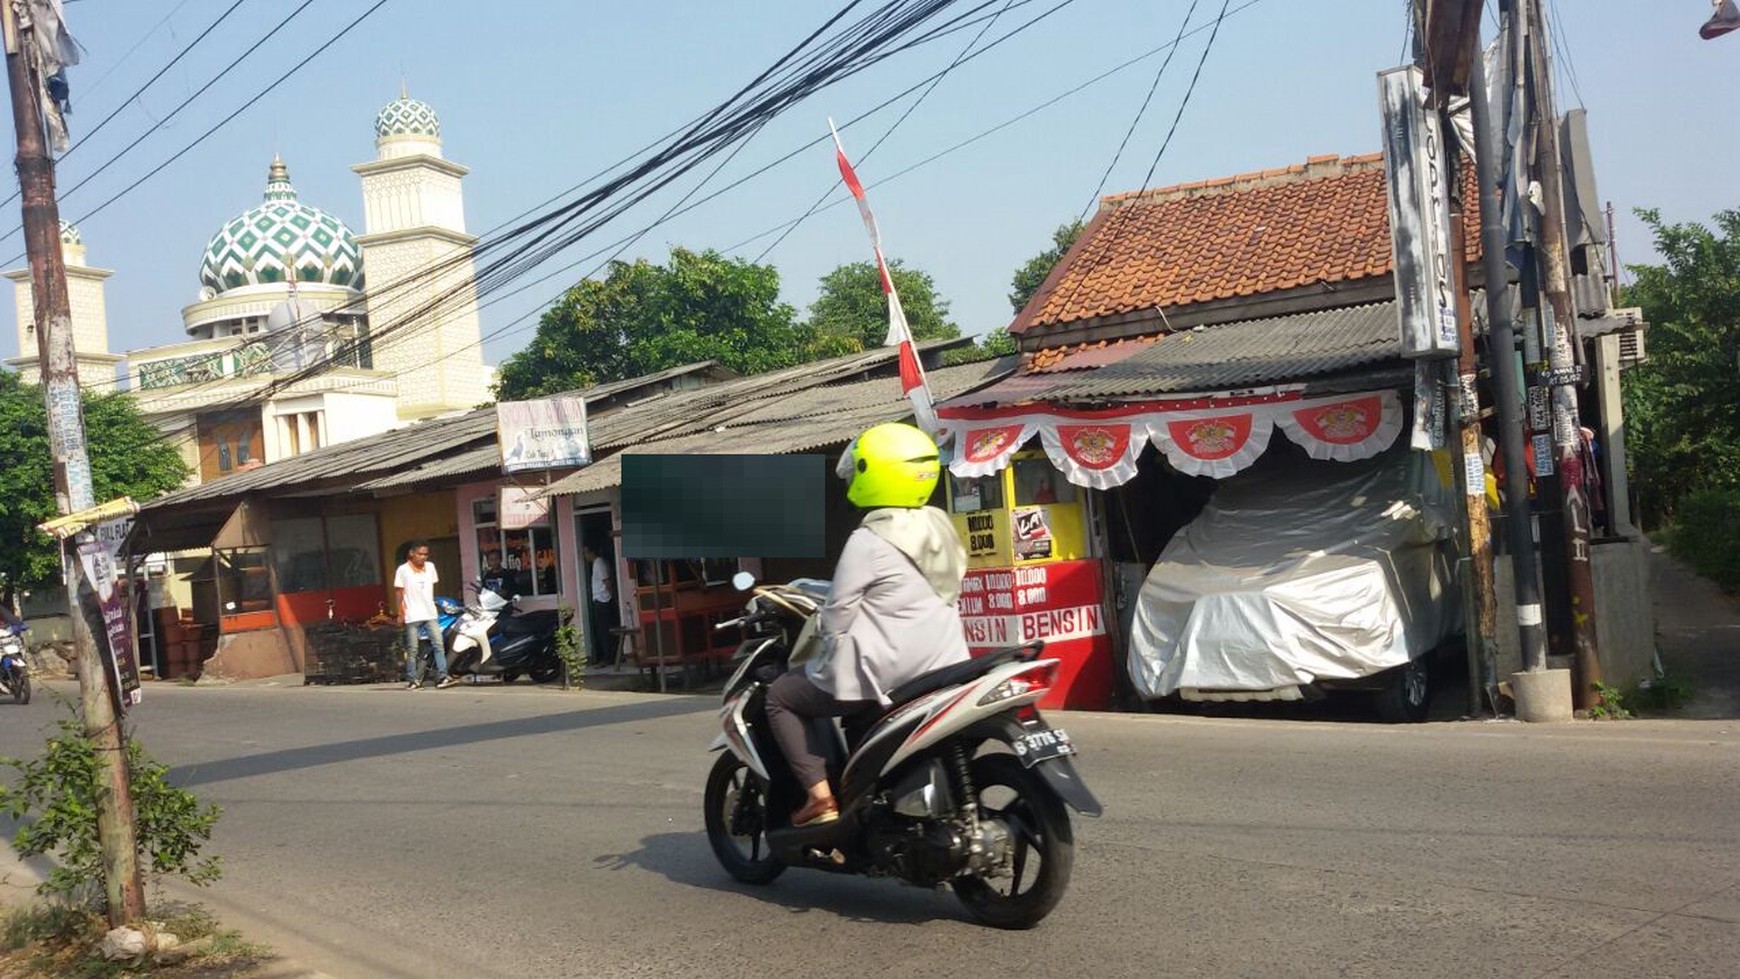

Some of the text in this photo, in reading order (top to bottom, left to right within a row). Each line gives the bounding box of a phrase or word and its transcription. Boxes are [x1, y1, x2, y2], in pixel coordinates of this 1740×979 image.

[1020, 513, 1039, 534] LA
[963, 617, 1007, 643] NSIN
[1022, 606, 1099, 641] BENSIN
[1013, 740, 1028, 756] B
